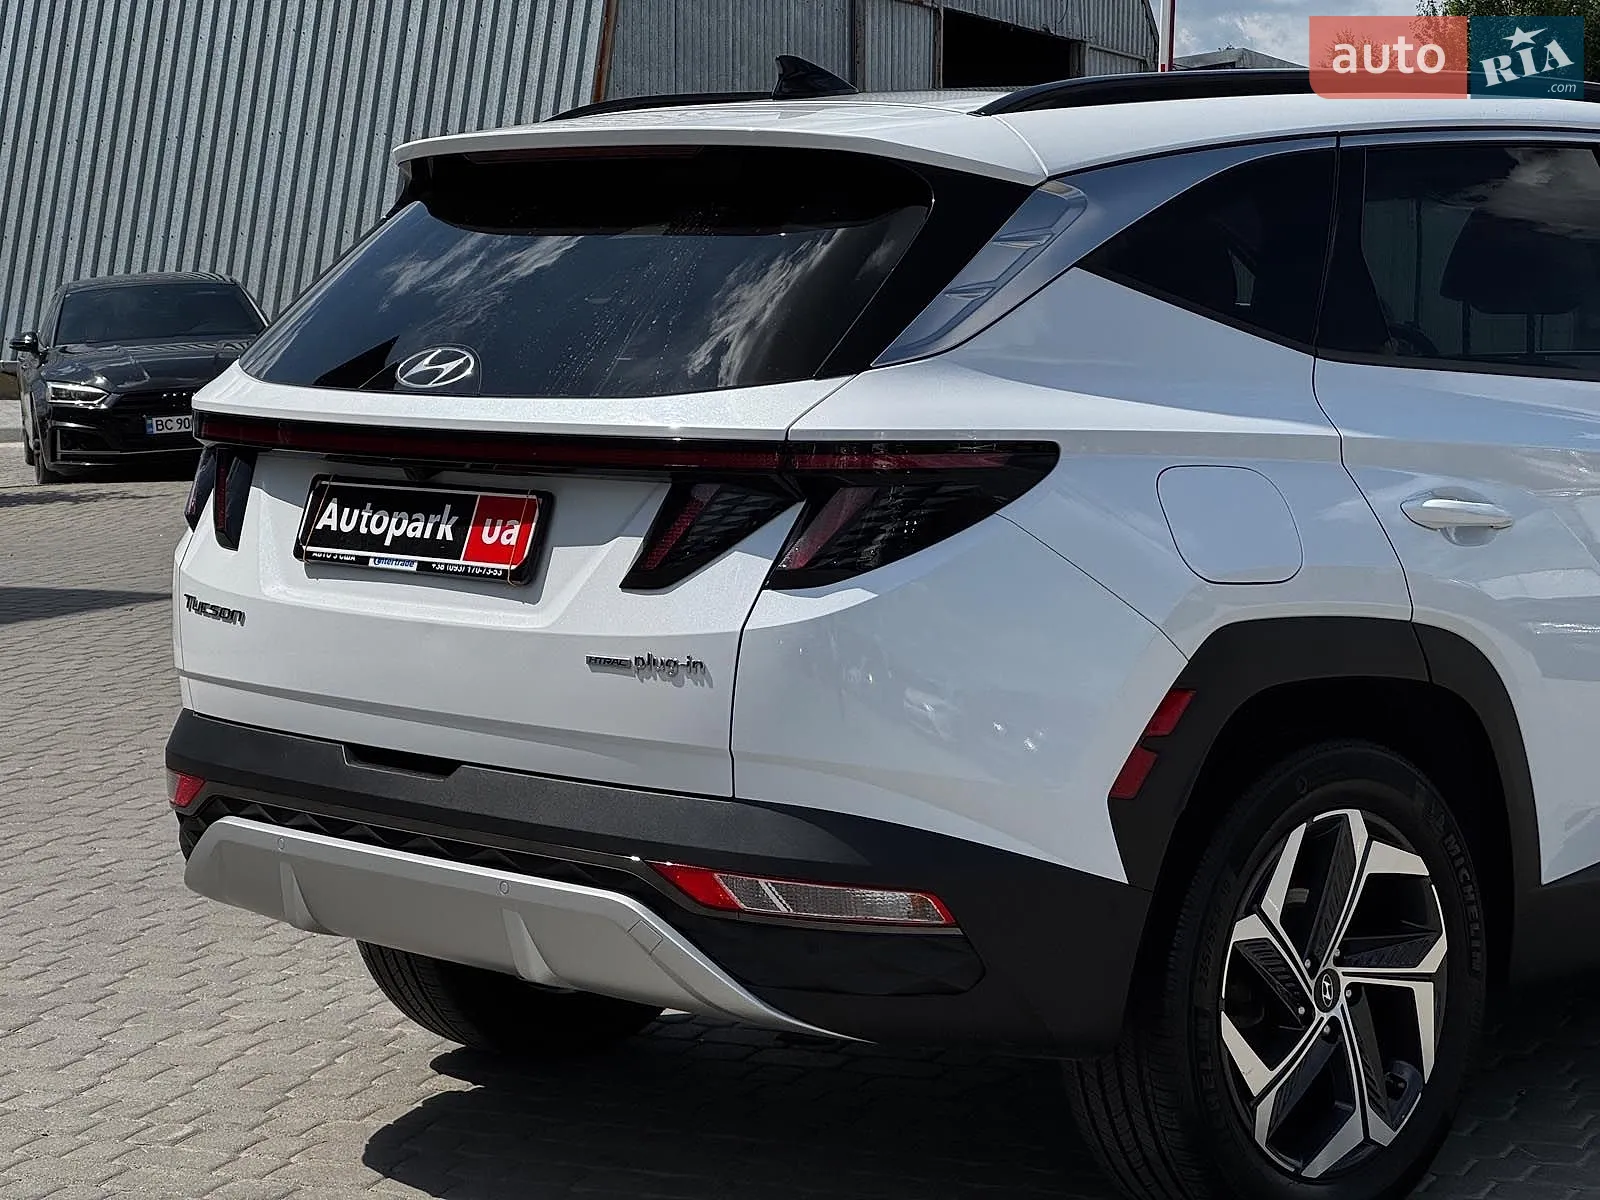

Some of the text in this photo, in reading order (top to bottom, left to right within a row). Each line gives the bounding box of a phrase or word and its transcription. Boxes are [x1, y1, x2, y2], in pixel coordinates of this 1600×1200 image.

[155, 417, 190, 431] BC 90
[315, 497, 521, 546] Autopark ua
[634, 652, 706, 677] plug-in
[1441, 832, 1482, 974] MICHELIN
